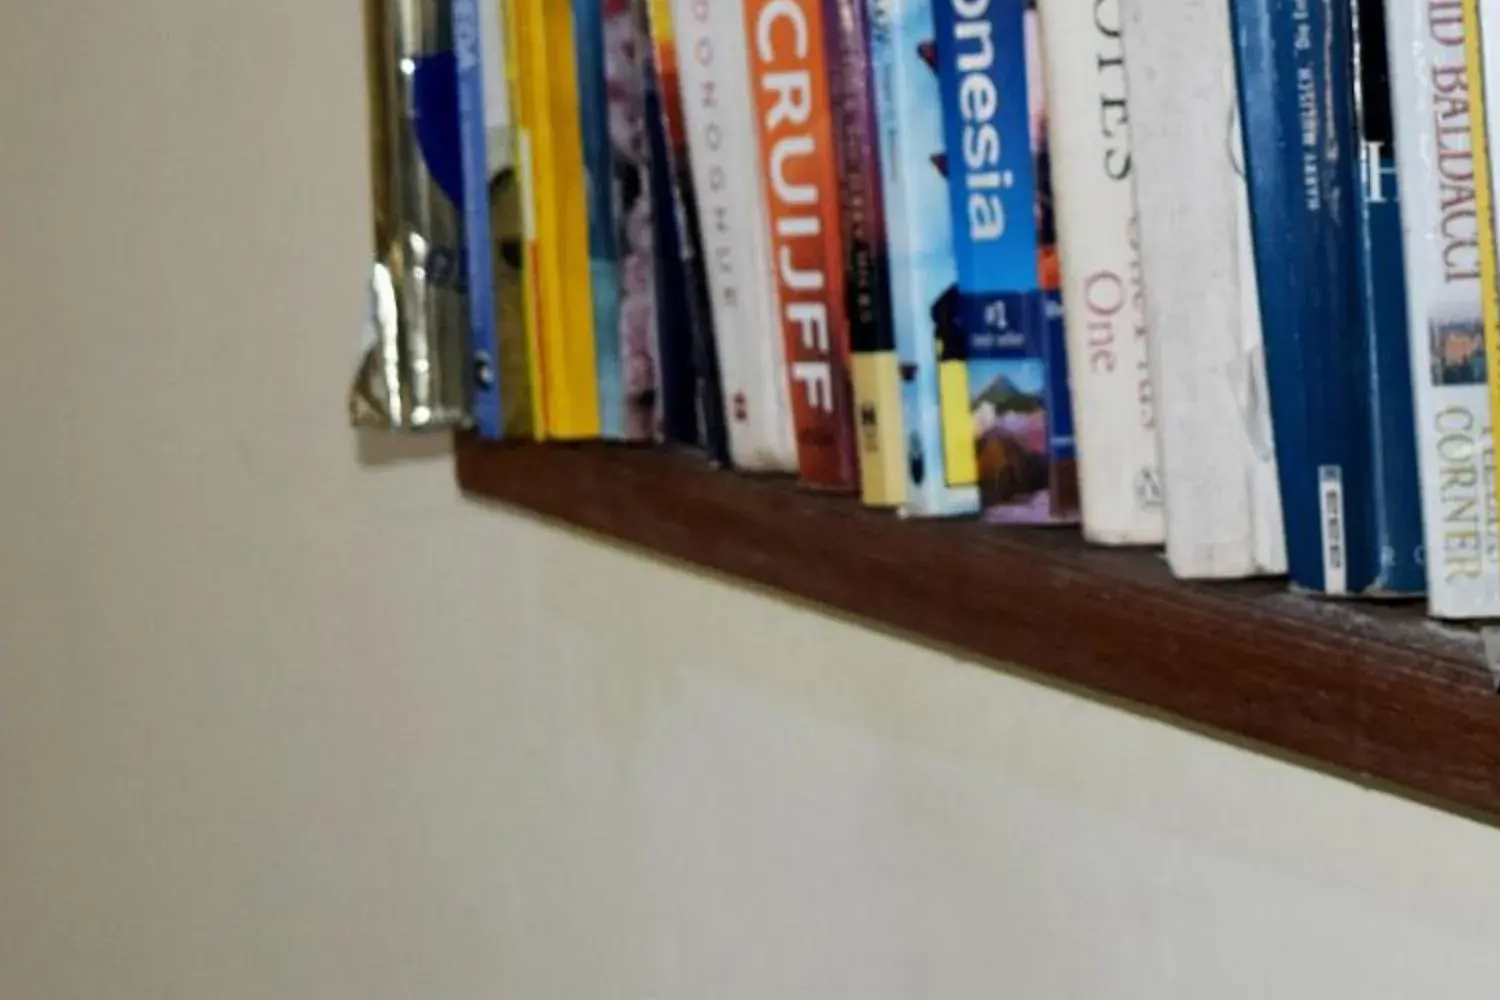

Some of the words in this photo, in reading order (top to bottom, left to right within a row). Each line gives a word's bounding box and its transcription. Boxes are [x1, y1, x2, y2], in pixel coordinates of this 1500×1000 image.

[1432, 64, 1484, 284] BALDACCI
[1083, 269, 1126, 376] One
[1434, 404, 1484, 586] CORNER
